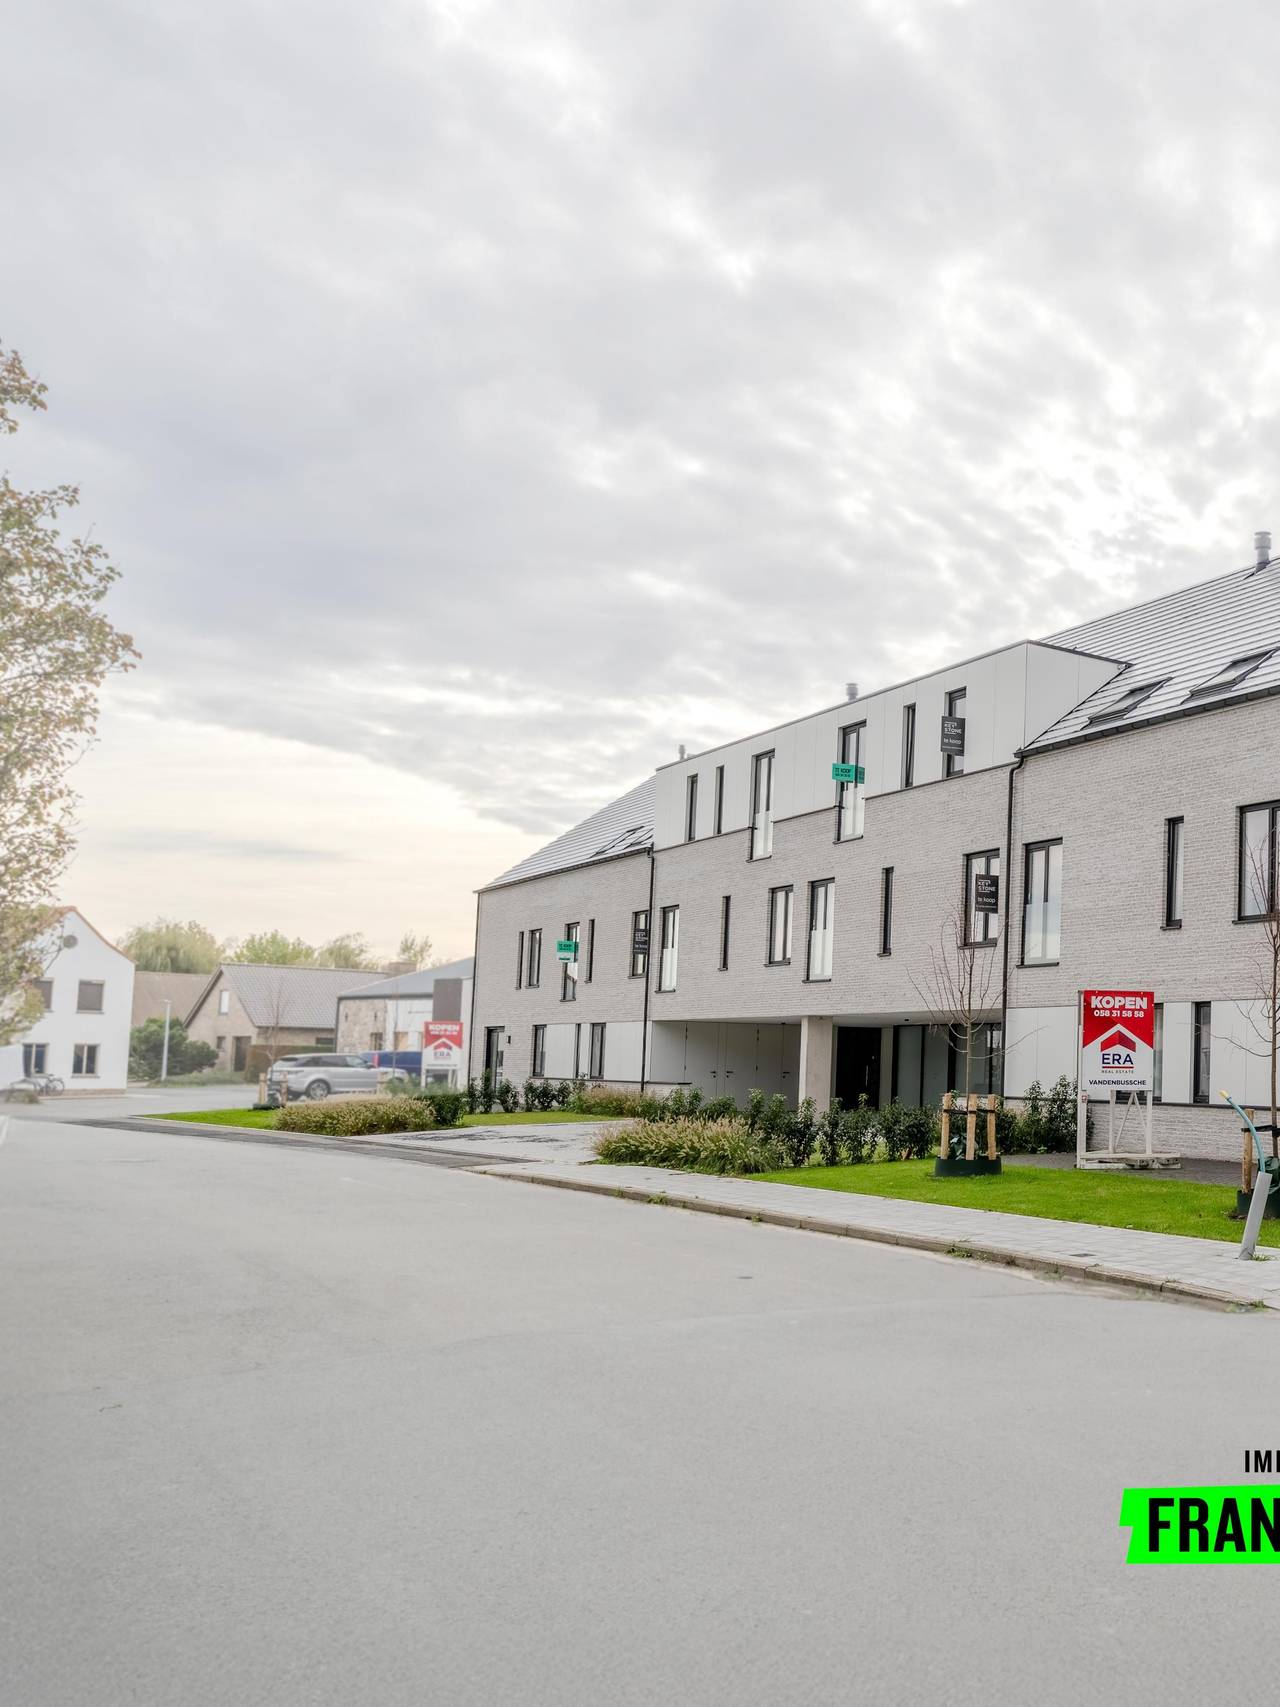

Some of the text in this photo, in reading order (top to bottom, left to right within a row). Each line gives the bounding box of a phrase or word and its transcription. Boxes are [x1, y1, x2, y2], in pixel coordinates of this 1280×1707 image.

[1091, 995, 1148, 1009] KOPEN
[1094, 1009, 1110, 1017] 058
[1134, 1010, 1145, 1018] 58
[1101, 1053, 1134, 1065] ERA
